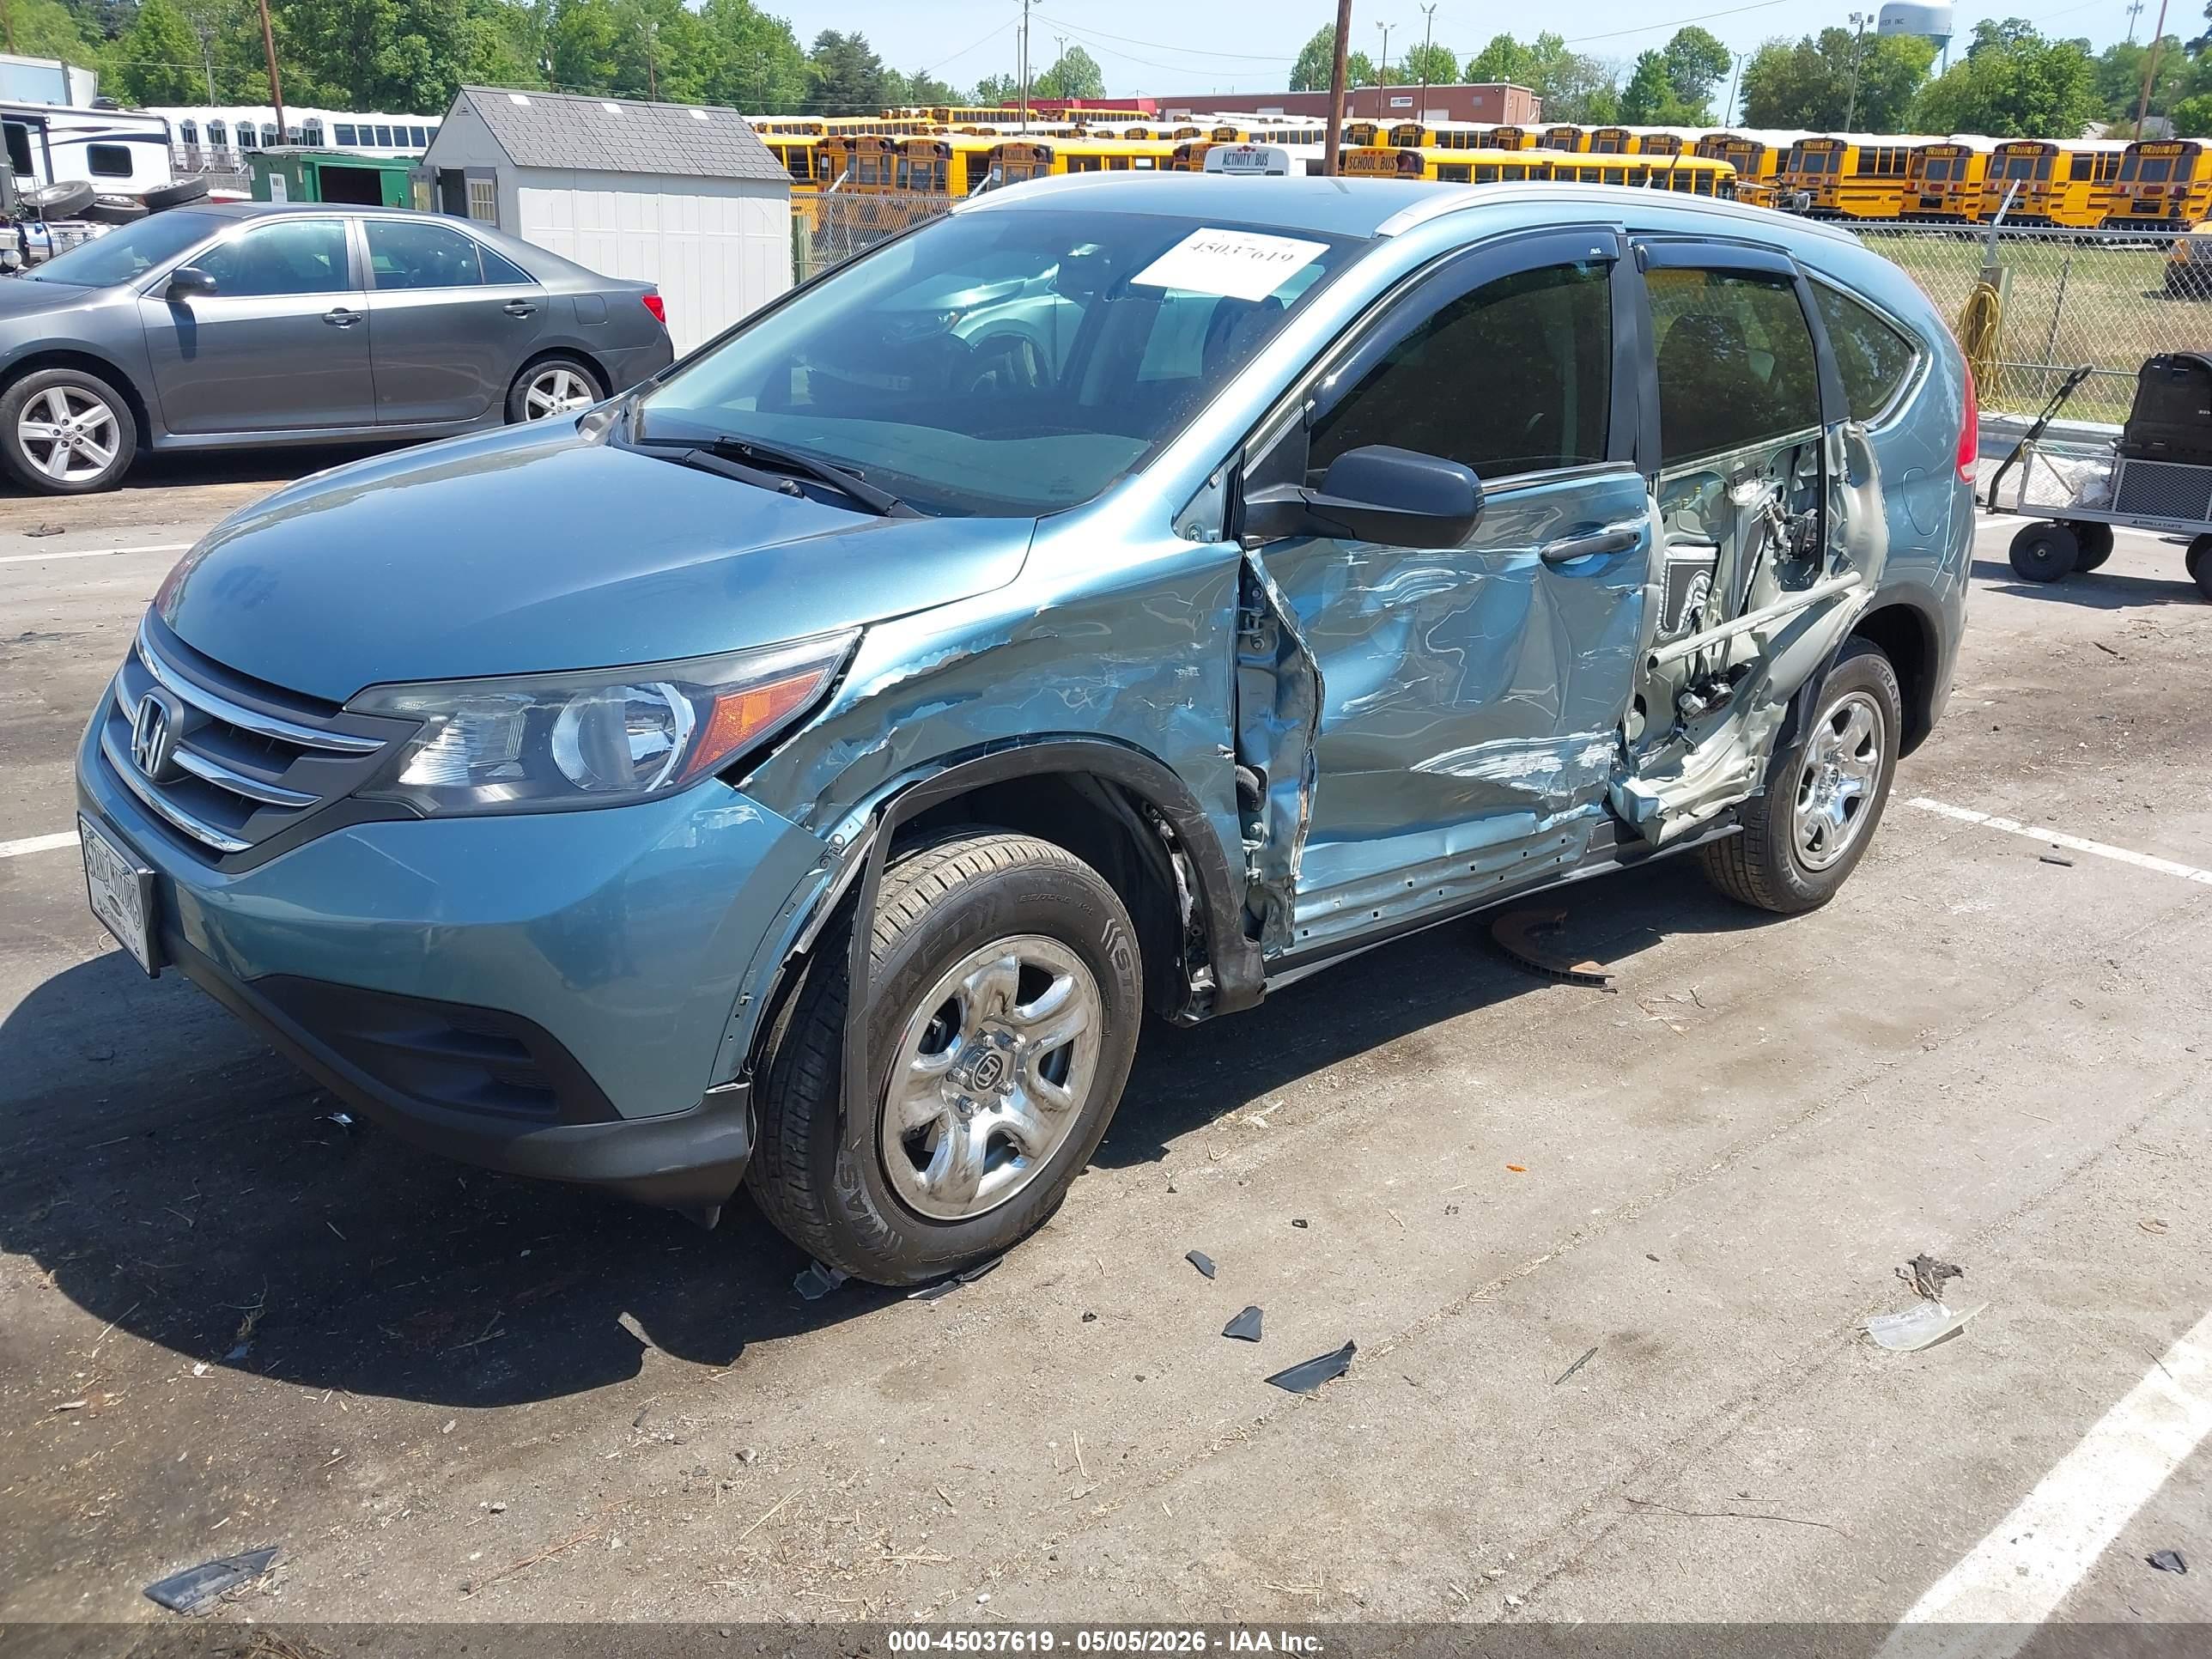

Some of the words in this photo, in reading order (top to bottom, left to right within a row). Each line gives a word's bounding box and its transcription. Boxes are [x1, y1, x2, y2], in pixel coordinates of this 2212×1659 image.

[1222, 152, 1250, 166] ACTIVITY
[1255, 152, 1270, 166] BUS
[1348, 156, 1376, 170] SCHOOL
[1380, 156, 1395, 170] BUS
